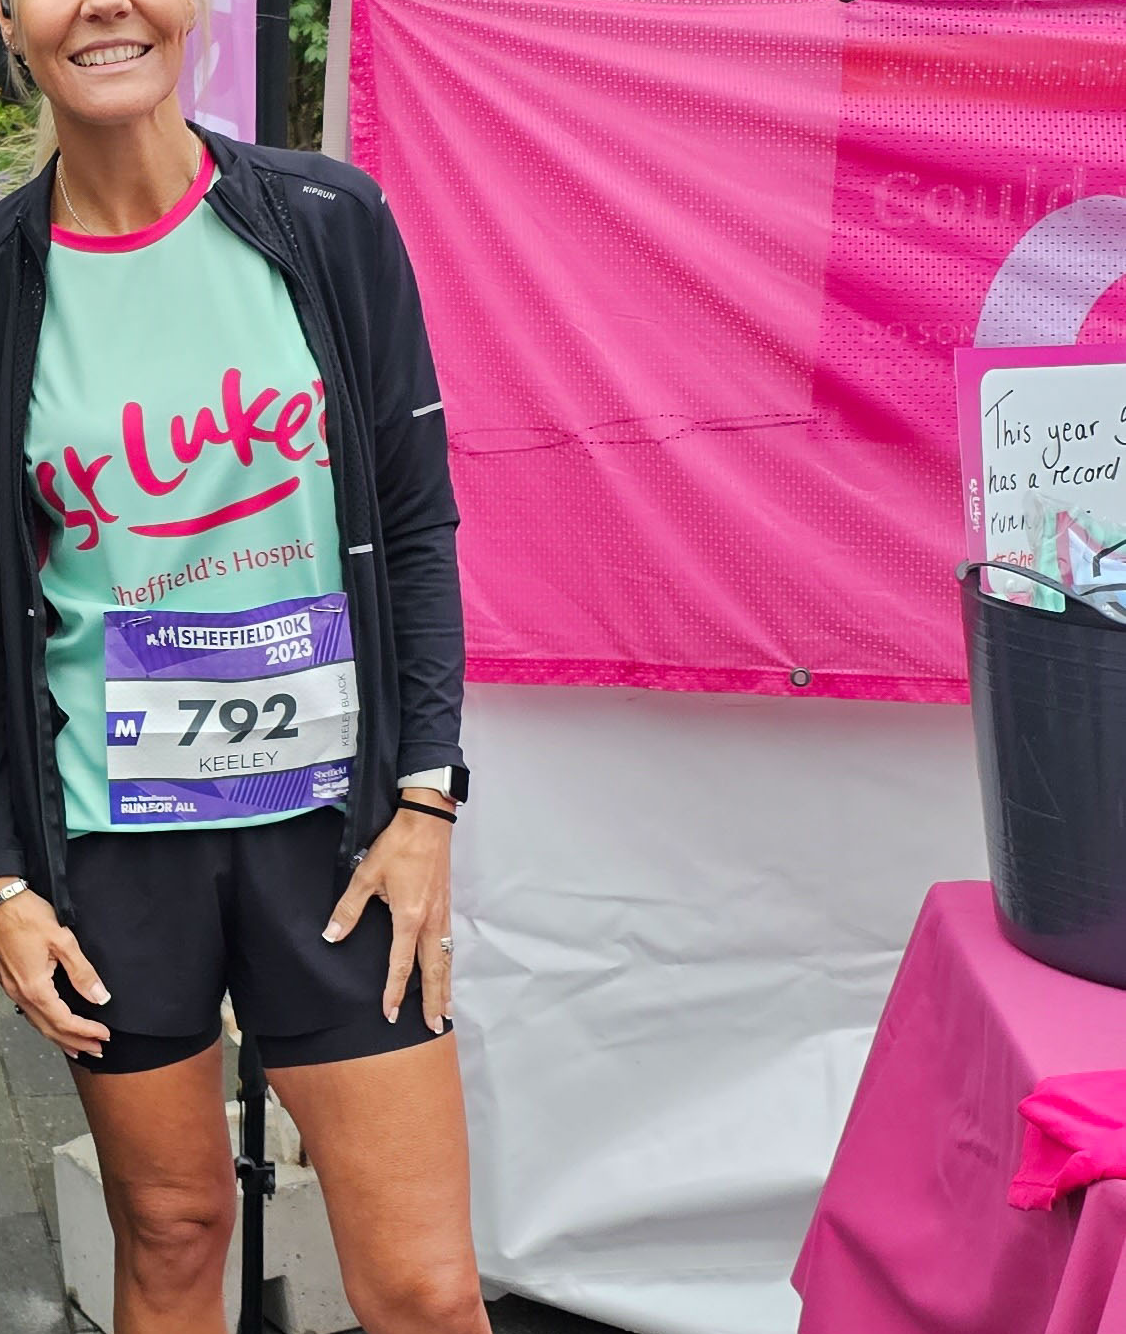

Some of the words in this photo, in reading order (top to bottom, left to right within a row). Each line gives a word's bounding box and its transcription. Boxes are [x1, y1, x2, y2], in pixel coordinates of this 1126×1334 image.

[302, 185, 337, 201] KIPRUN
[873, 165, 1086, 227] Could
[985, 390, 1032, 449] This
[1042, 420, 1100, 469] year
[989, 466, 1017, 494] has
[1029, 473, 1040, 489] a
[1053, 457, 1121, 486] record
[36, 446, 120, 551] St
[113, 557, 227, 606] heffield's
[234, 539, 315, 571] Hospic
[182, 625, 274, 646] SHEFFIELD
[277, 615, 309, 637] 10K
[266, 638, 314, 666] 2023
[338, 673, 347, 707] BLACK
[114, 720, 137, 738] M
[177, 693, 299, 747] 792
[341, 710, 349, 747] KEELEY
[199, 750, 279, 773] KEELEY
[121, 803, 147, 814] RUN
[175, 802, 197, 813] ALL
